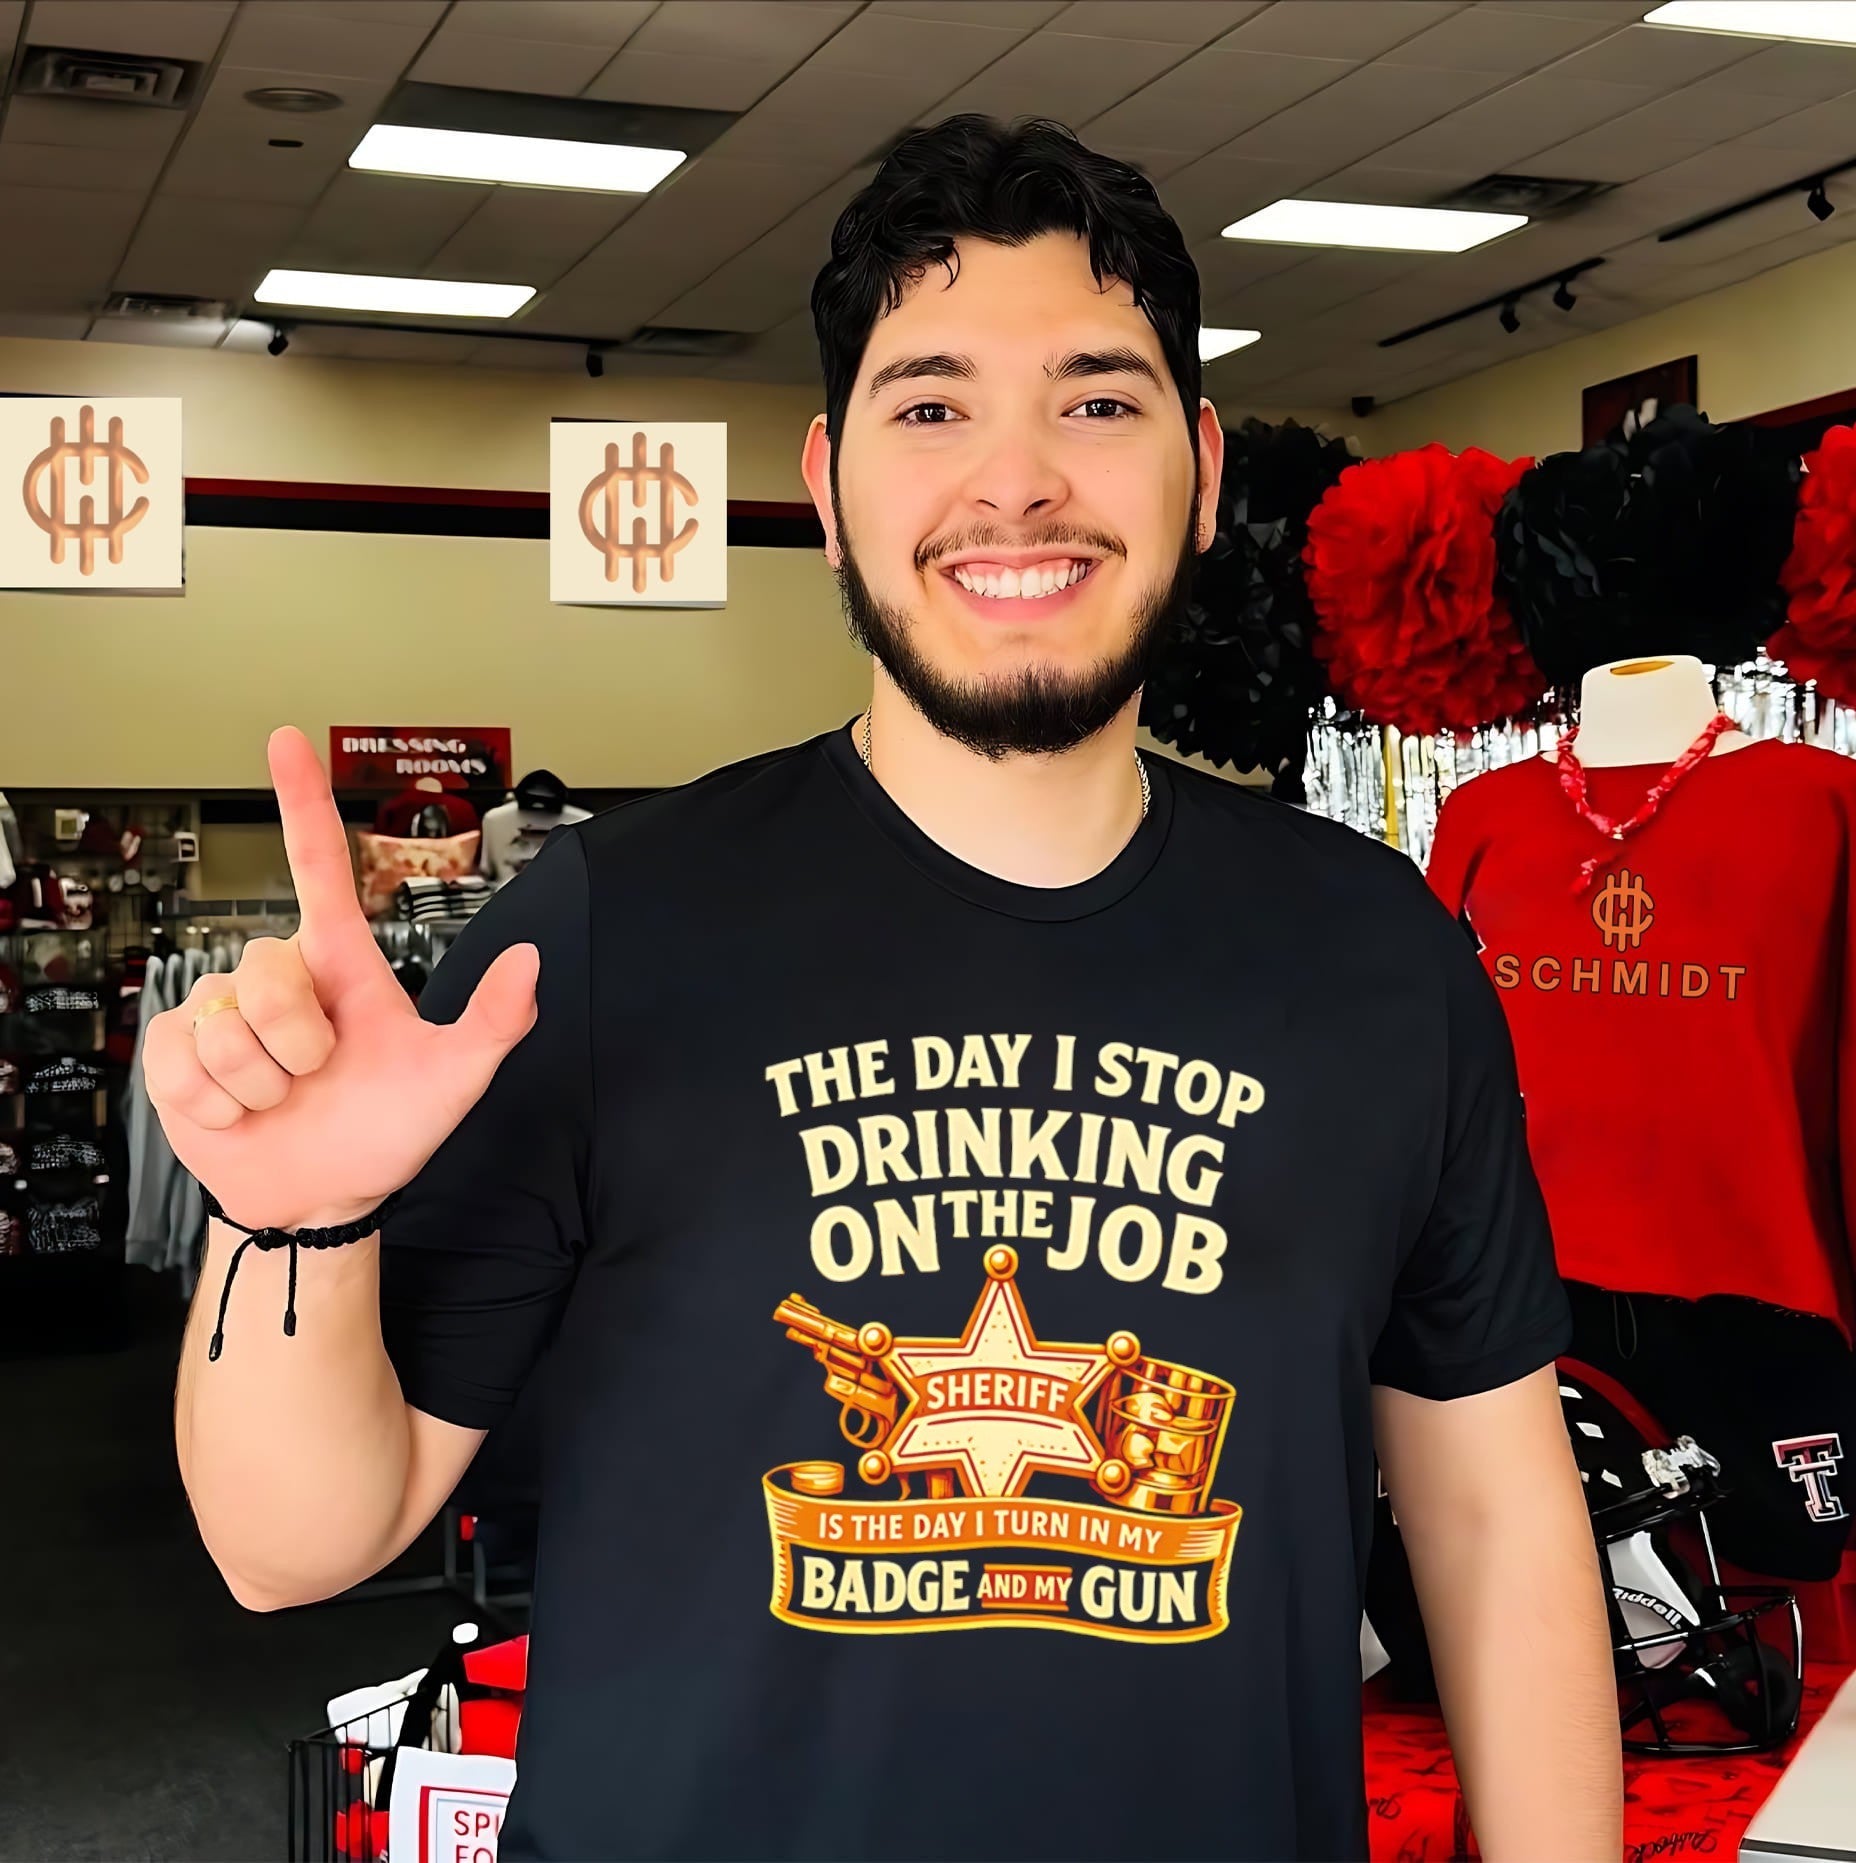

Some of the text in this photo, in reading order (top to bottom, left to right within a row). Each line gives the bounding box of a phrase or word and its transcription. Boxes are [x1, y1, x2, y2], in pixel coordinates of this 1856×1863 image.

[342, 737, 467, 754] DRESSING
[396, 758, 487, 776] ROOMS
[1494, 954, 1747, 1001] SCHMIDT
[765, 1034, 1265, 1128] THE DAY I STOP
[799, 1107, 1225, 1207] DRINKING
[810, 1190, 1228, 1295] ON THE JOB
[926, 1373, 1069, 1413] SHERIFF
[819, 1509, 1163, 1554] IS THE DAY I TURN IN MY
[801, 1556, 1198, 1624] BADGE AND MY GUN
